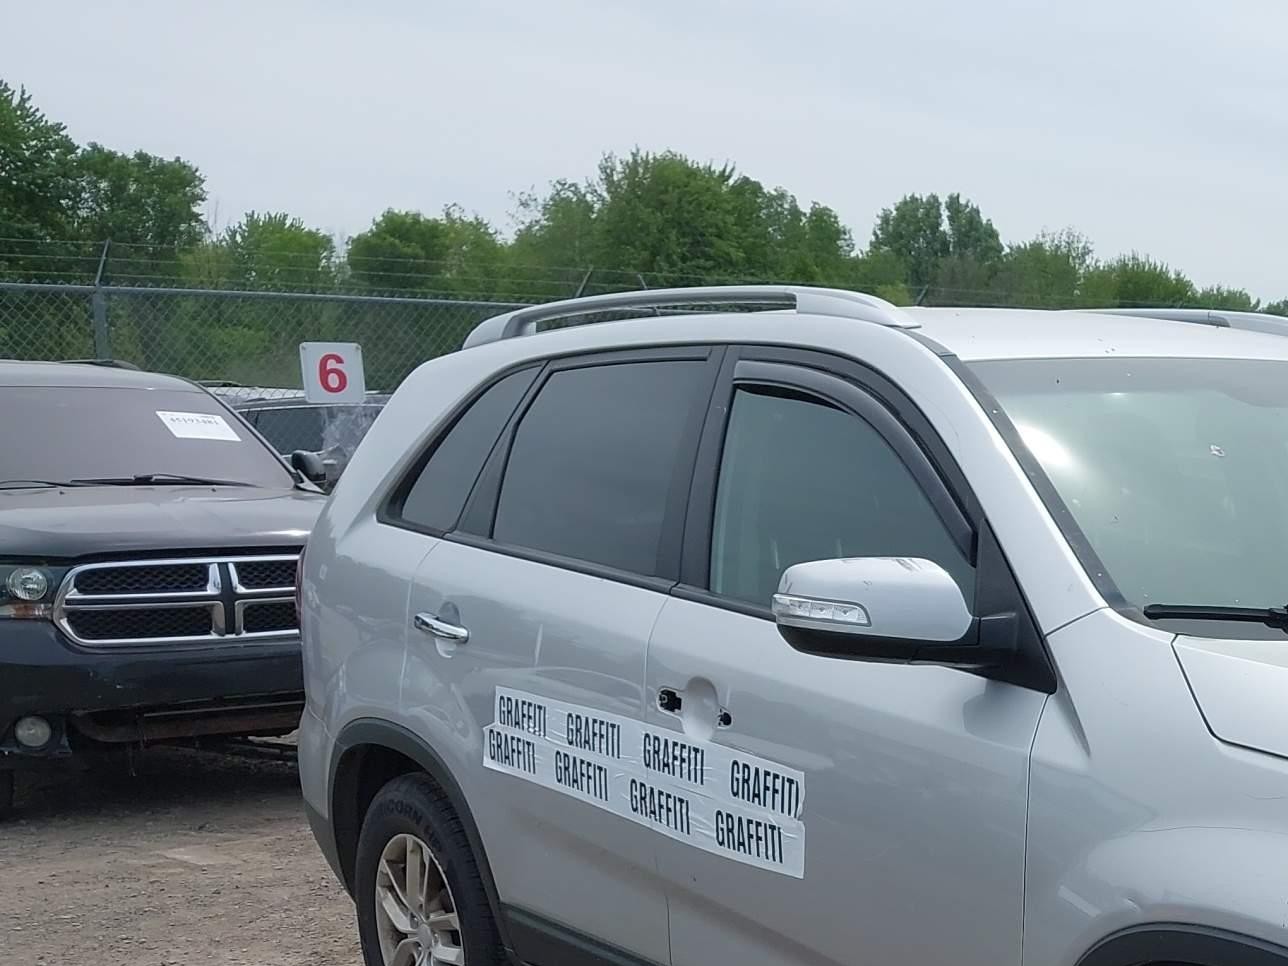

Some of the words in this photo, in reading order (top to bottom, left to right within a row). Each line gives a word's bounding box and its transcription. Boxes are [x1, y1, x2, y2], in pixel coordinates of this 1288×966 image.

[318, 353, 347, 393] 6
[488, 728, 537, 775] GRAFFITI
[554, 750, 609, 802] GRAFFITI
[629, 778, 691, 836] GRAFFITI
[714, 809, 784, 864] GRAFFITI
[498, 695, 548, 738] GRAFFITI
[566, 712, 621, 760] GRAFFITI
[643, 732, 705, 786] GRAFFITI
[730, 759, 800, 819] GRAFFITI
